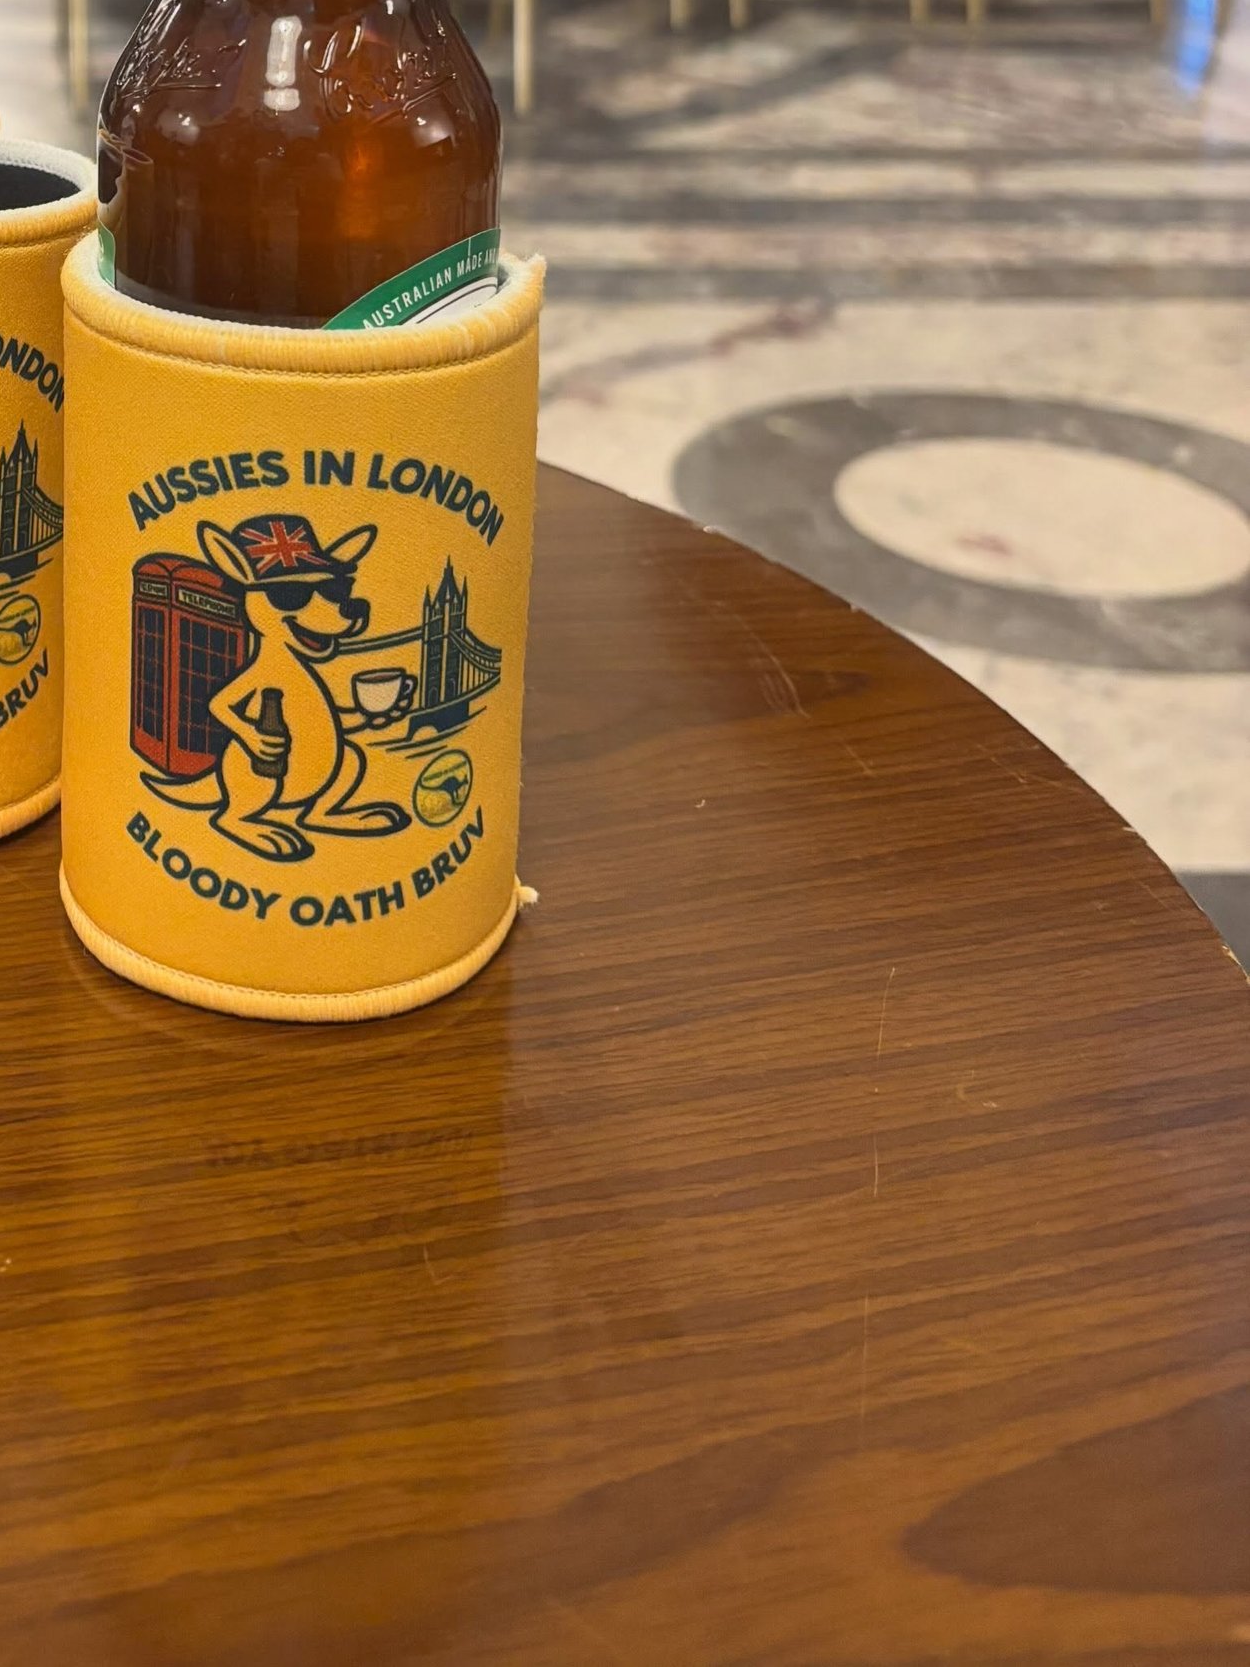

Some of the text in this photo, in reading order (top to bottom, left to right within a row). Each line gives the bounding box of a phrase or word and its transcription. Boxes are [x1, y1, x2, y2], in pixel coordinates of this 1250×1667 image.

[362, 266, 452, 330] AUSTRALIAN
[456, 251, 483, 278] MADE
[128, 450, 504, 547] AUSSIES IN LONDON
[126, 805, 485, 927] BLOODY OATH BRUV
